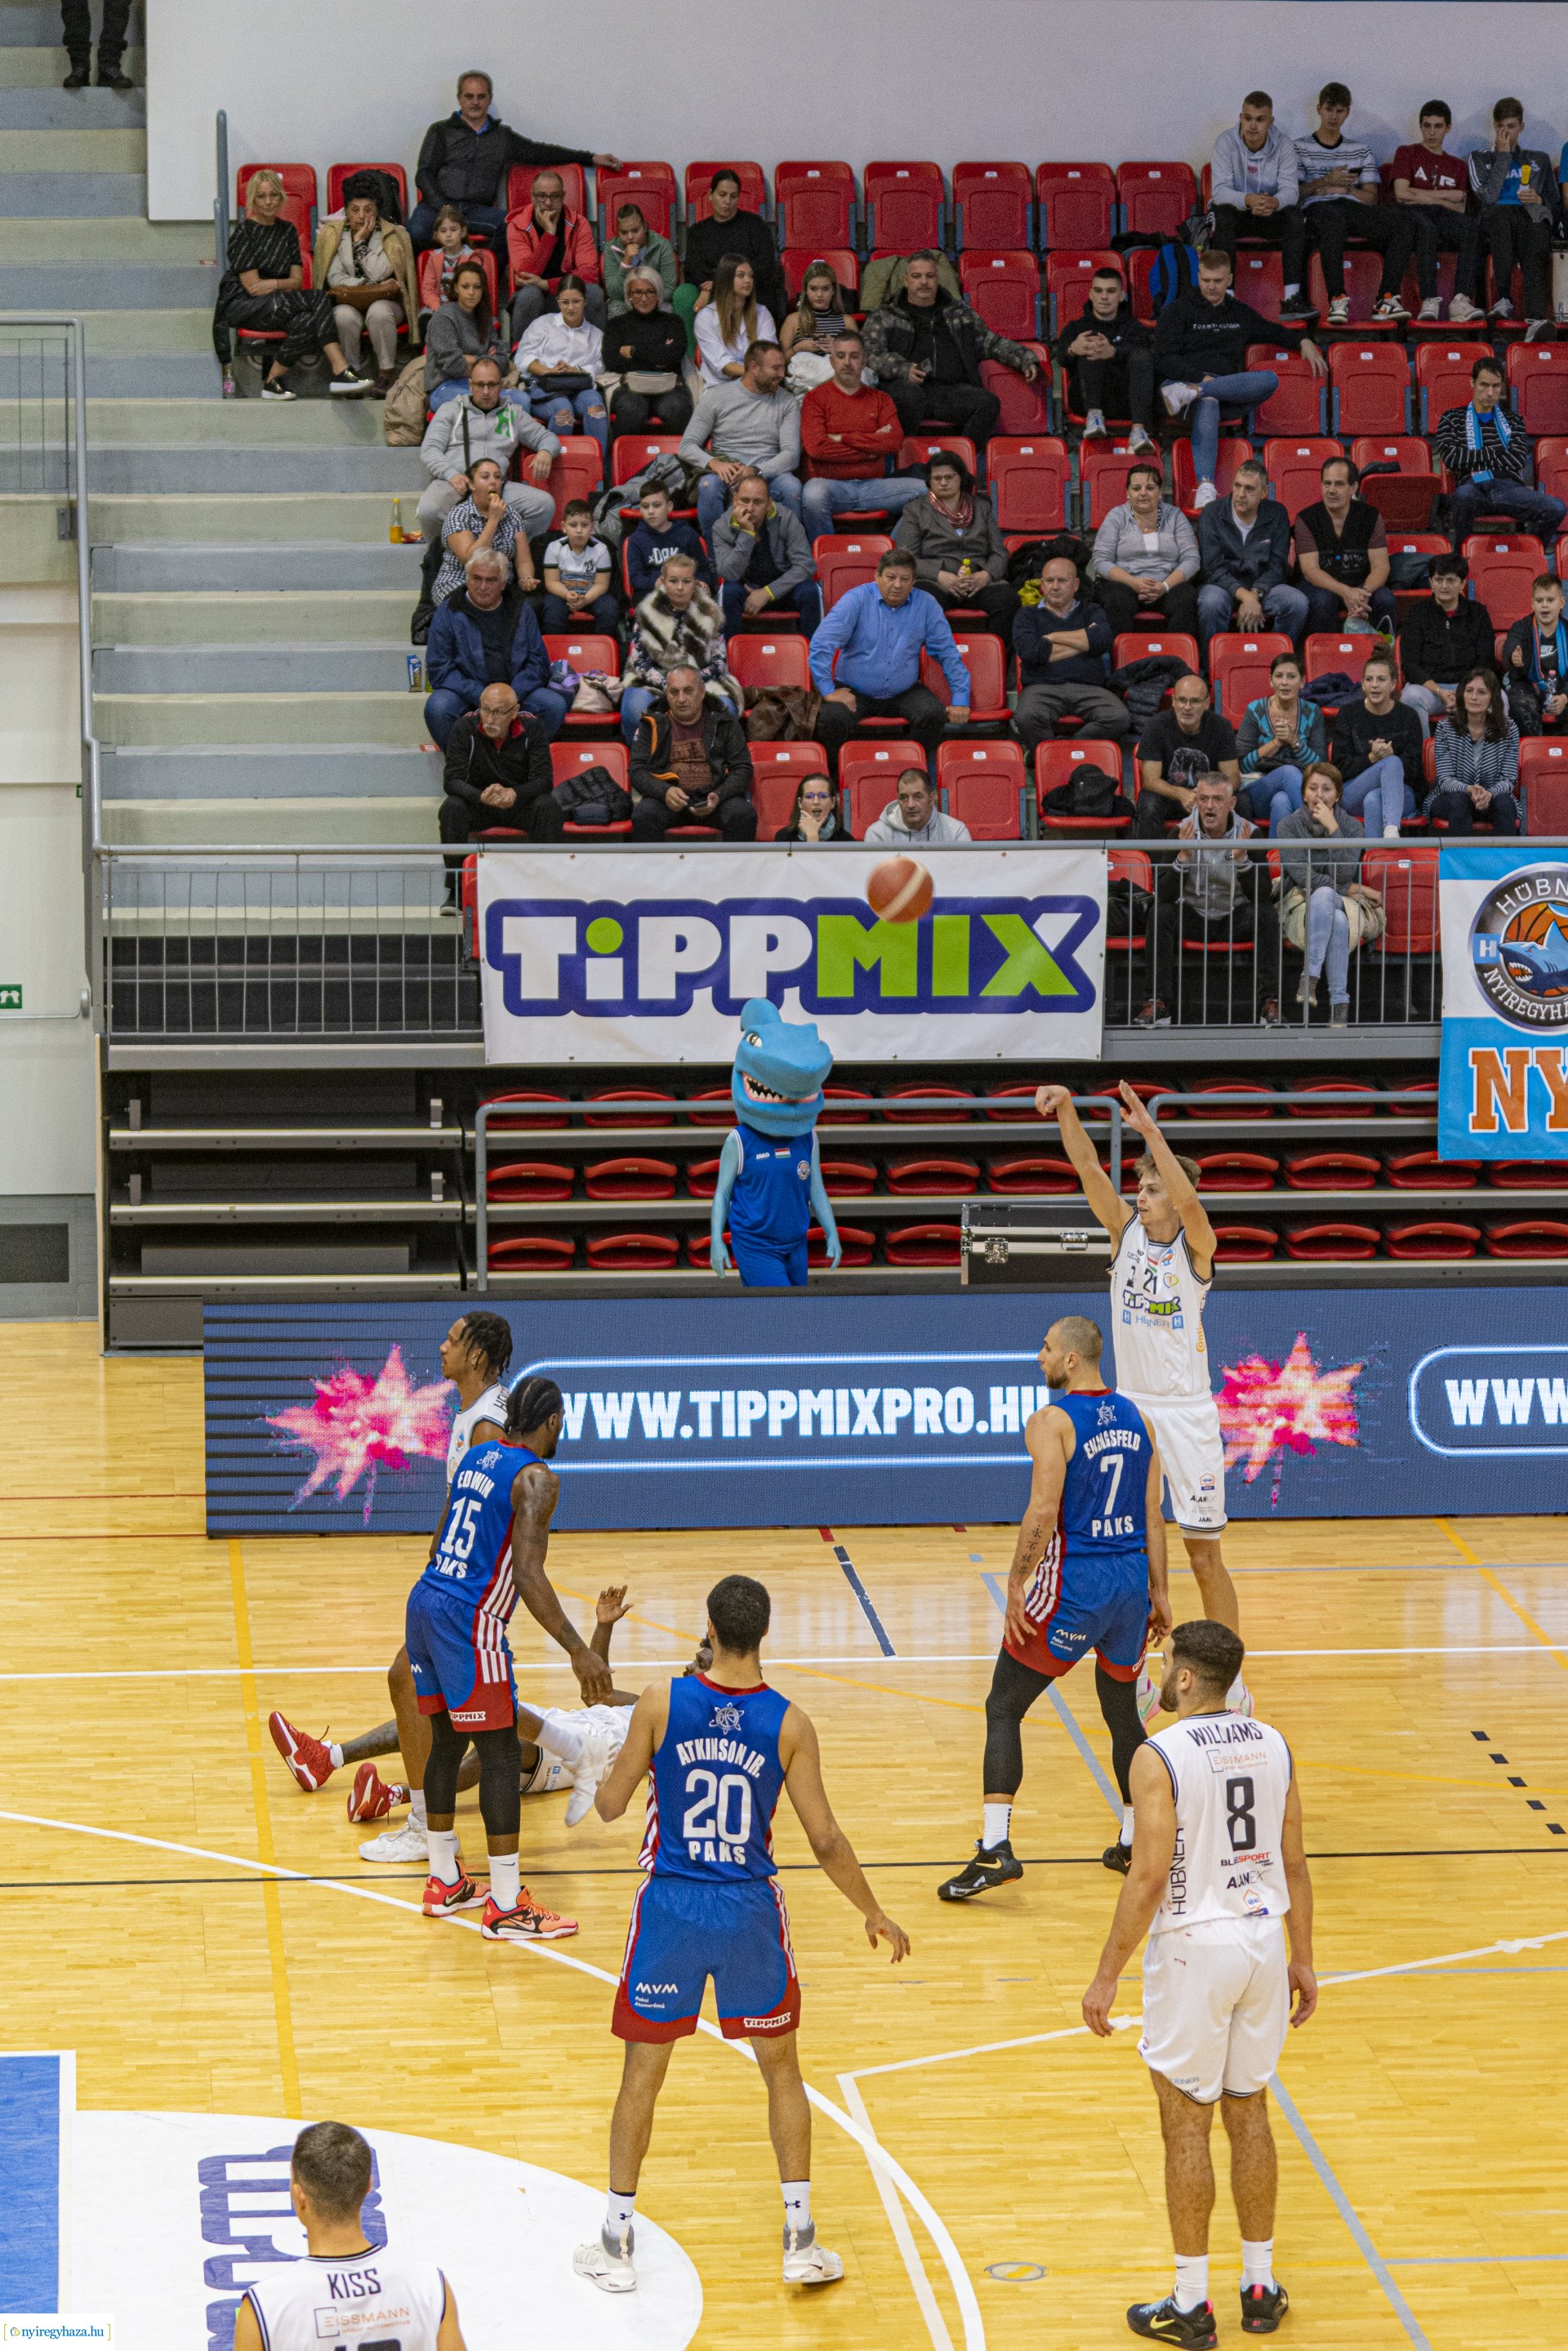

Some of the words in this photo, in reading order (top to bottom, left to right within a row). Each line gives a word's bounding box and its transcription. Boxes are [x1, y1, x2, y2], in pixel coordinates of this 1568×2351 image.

[584, 560, 595, 573] 23
[1479, 940, 1497, 957] H
[755, 1152, 771, 1160] JAKO
[1143, 1267, 1158, 1295] 21
[457, 1469, 496, 1500] EDWIN
[1100, 1453, 1125, 1515] 7
[441, 1496, 483, 1559] 15
[1091, 1515, 1135, 1537] PAKS
[1186, 1722, 1263, 1747] WILLIAMS
[675, 1738, 747, 1767] ATKINSON
[683, 1769, 752, 1845] 20
[1226, 1776, 1257, 1853] 8
[688, 1840, 746, 1866] PAKS
[635, 1982, 679, 1995] MVM
[635, 1995, 650, 2003] Paksi
[327, 2267, 382, 2300] KISS
